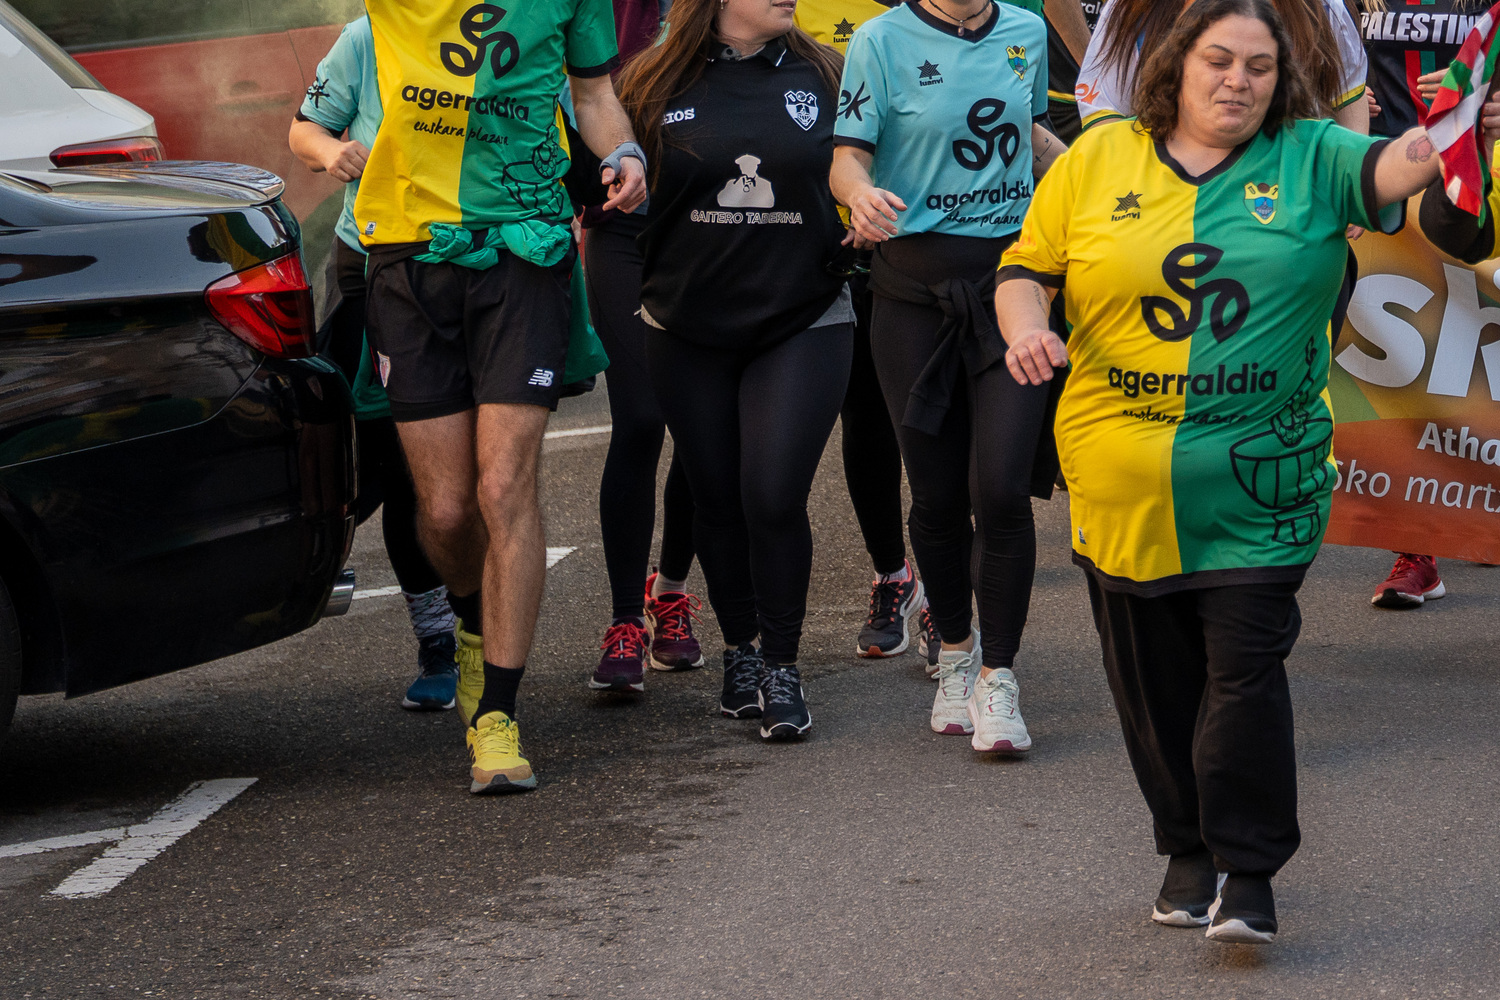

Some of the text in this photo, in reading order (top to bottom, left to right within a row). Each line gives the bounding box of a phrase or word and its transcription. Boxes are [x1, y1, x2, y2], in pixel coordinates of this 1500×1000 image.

[1361, 12, 1479, 45] PALESTIN
[833, 36, 851, 44] luan
[919, 77, 944, 87] luanvi
[401, 85, 530, 121] agerraldia
[414, 117, 465, 138] euskara
[690, 209, 803, 225] GAITERO TABERNA
[1108, 362, 1277, 398] agerraldia
